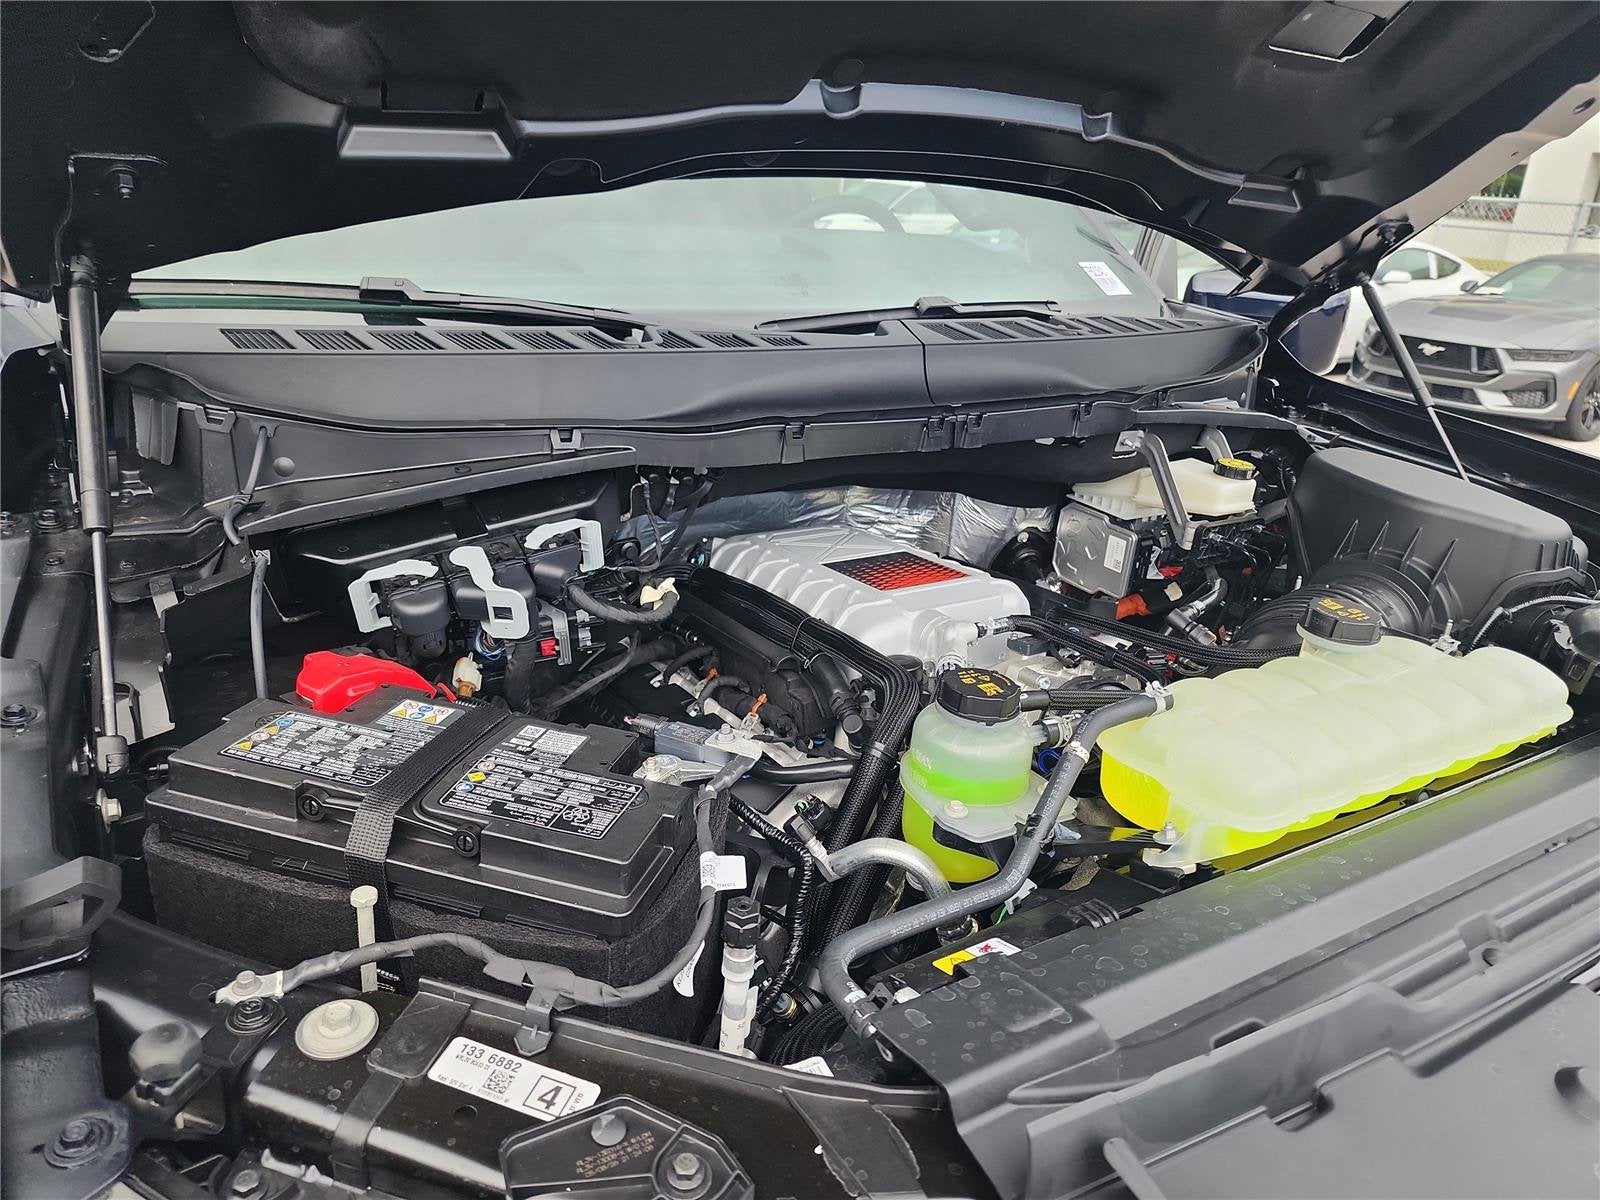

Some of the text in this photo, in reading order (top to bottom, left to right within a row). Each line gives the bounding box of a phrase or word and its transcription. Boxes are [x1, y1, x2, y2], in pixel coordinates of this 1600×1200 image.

[462, 1043, 486, 1059] 133
[487, 1053, 523, 1074] 6882
[537, 1085, 564, 1111] 4
